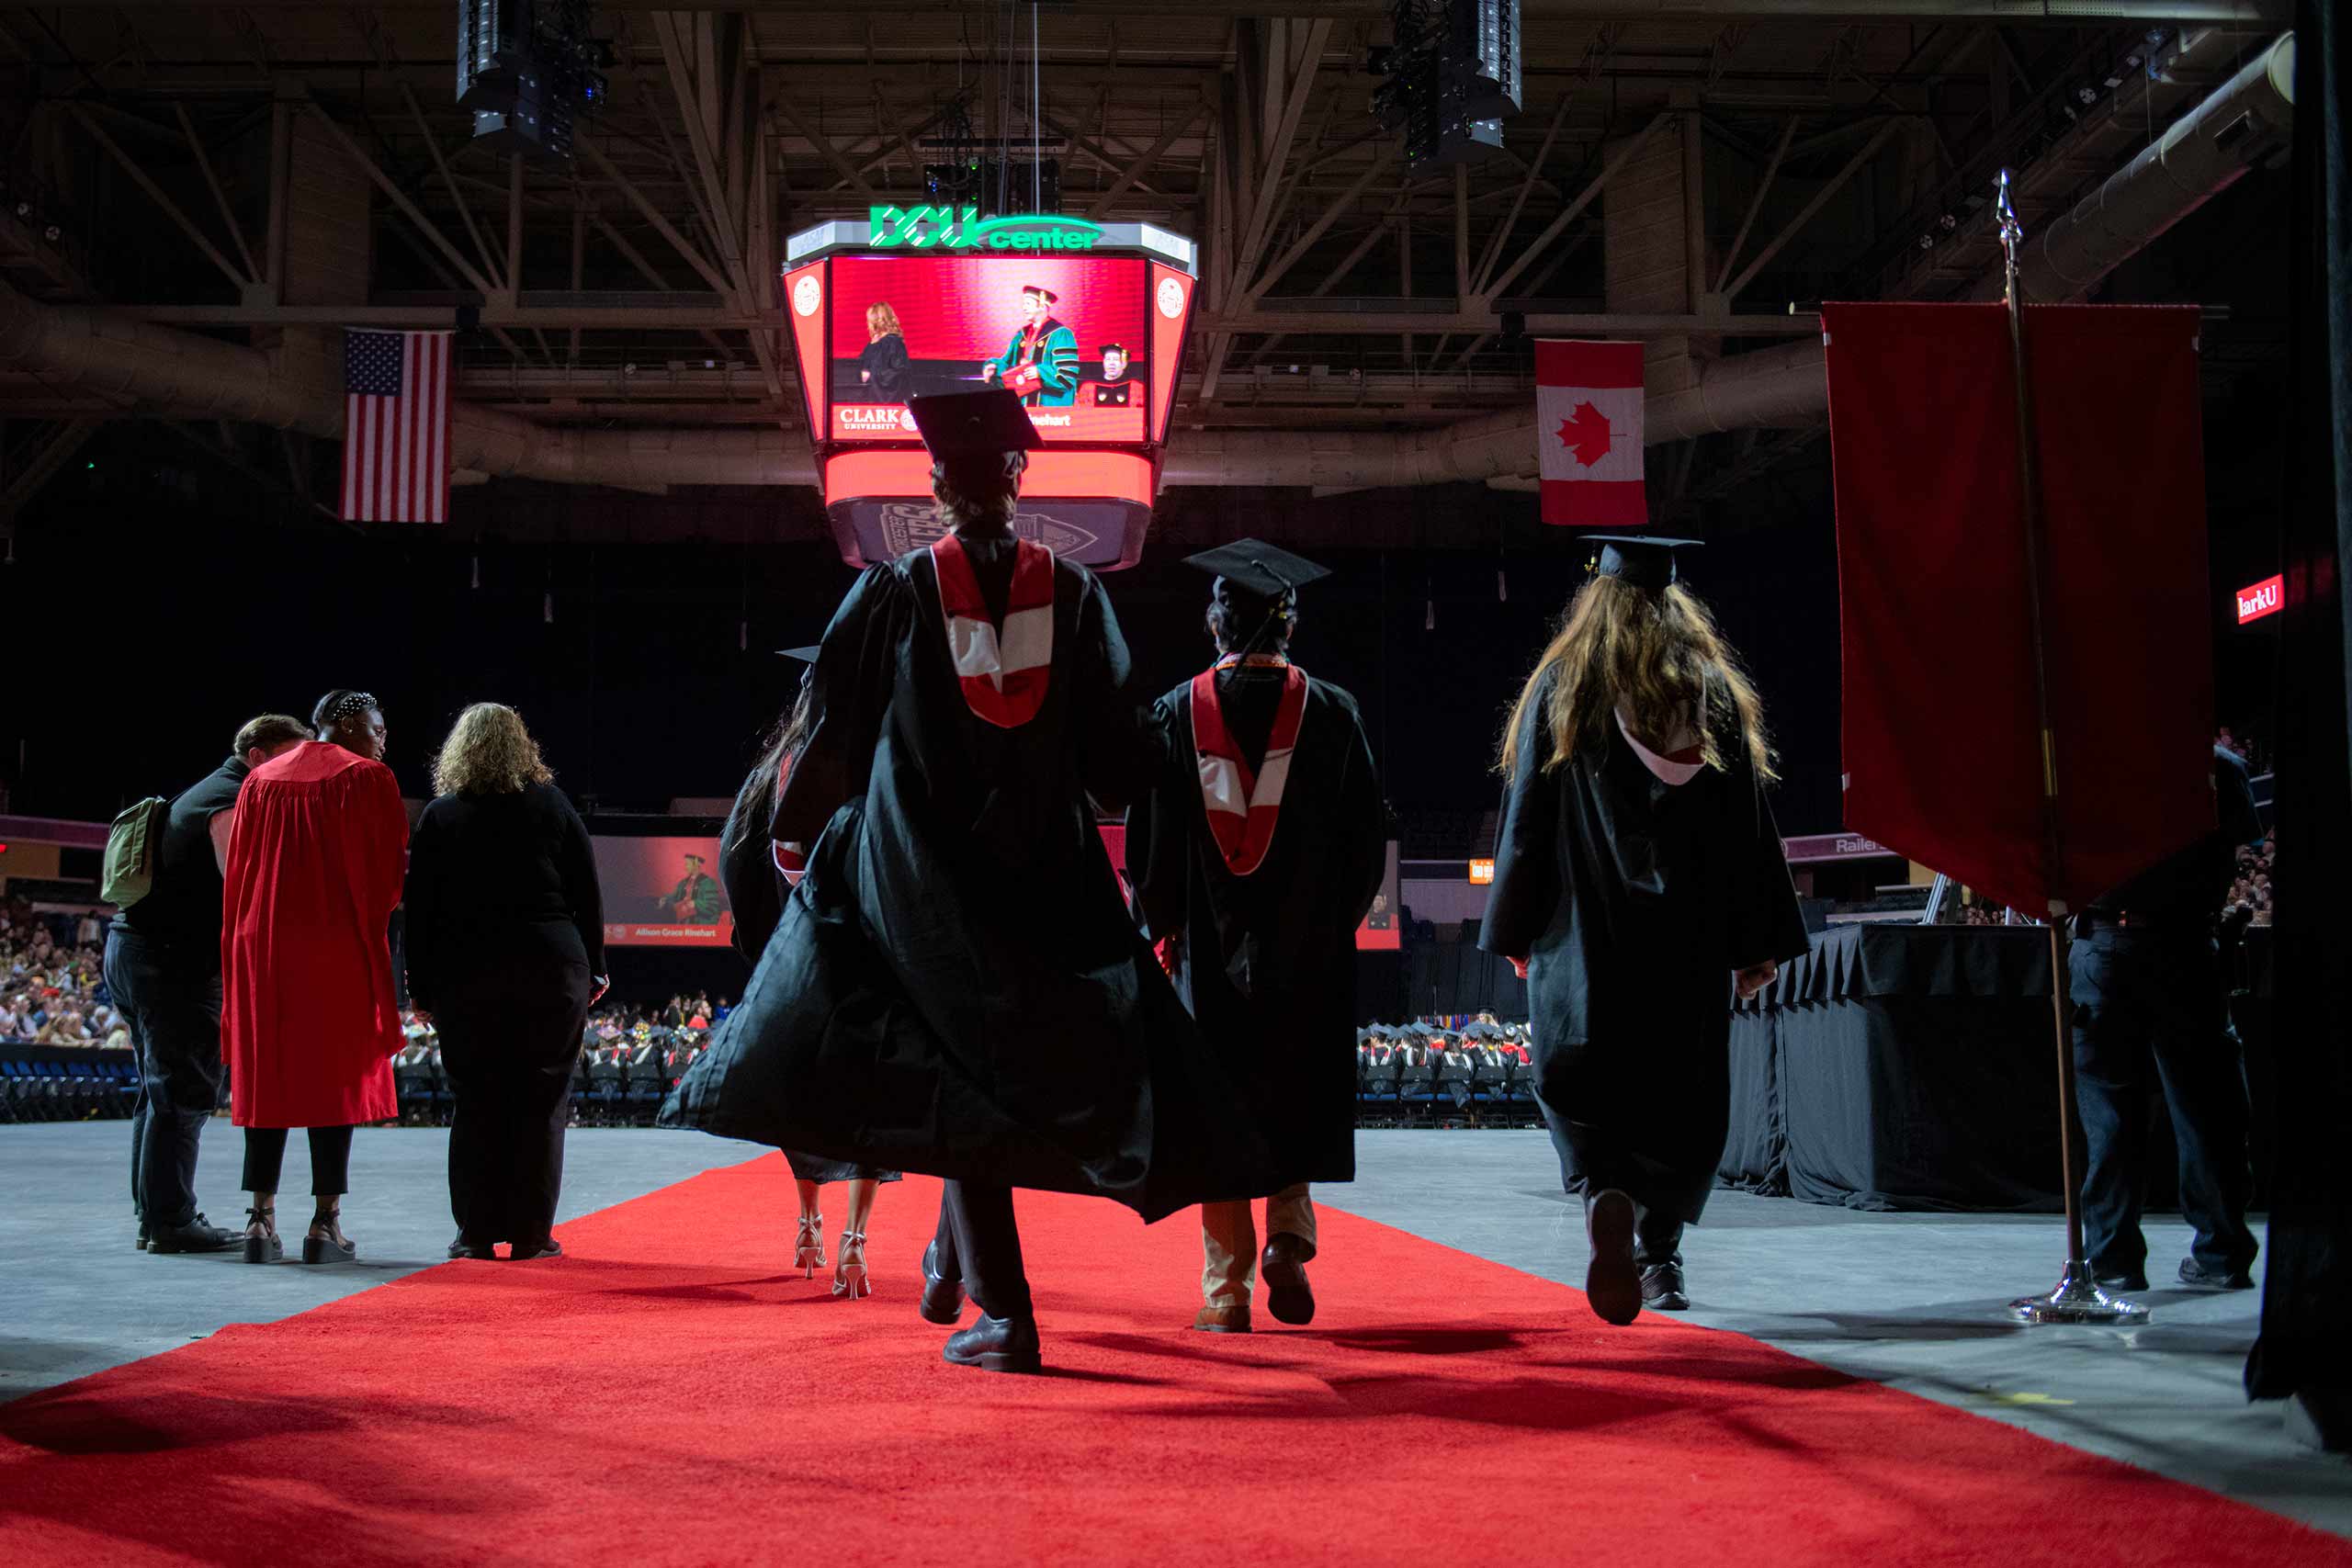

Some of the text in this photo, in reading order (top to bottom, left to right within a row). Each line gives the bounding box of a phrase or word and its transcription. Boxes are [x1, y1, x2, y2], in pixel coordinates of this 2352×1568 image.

[869, 207, 1100, 248] DCU center
[840, 409, 899, 423] CLARK
[1028, 413, 1070, 426] inehart
[2238, 585, 2277, 617] larkU
[1836, 838, 1887, 852] Railer
[662, 928, 683, 936] Grace
